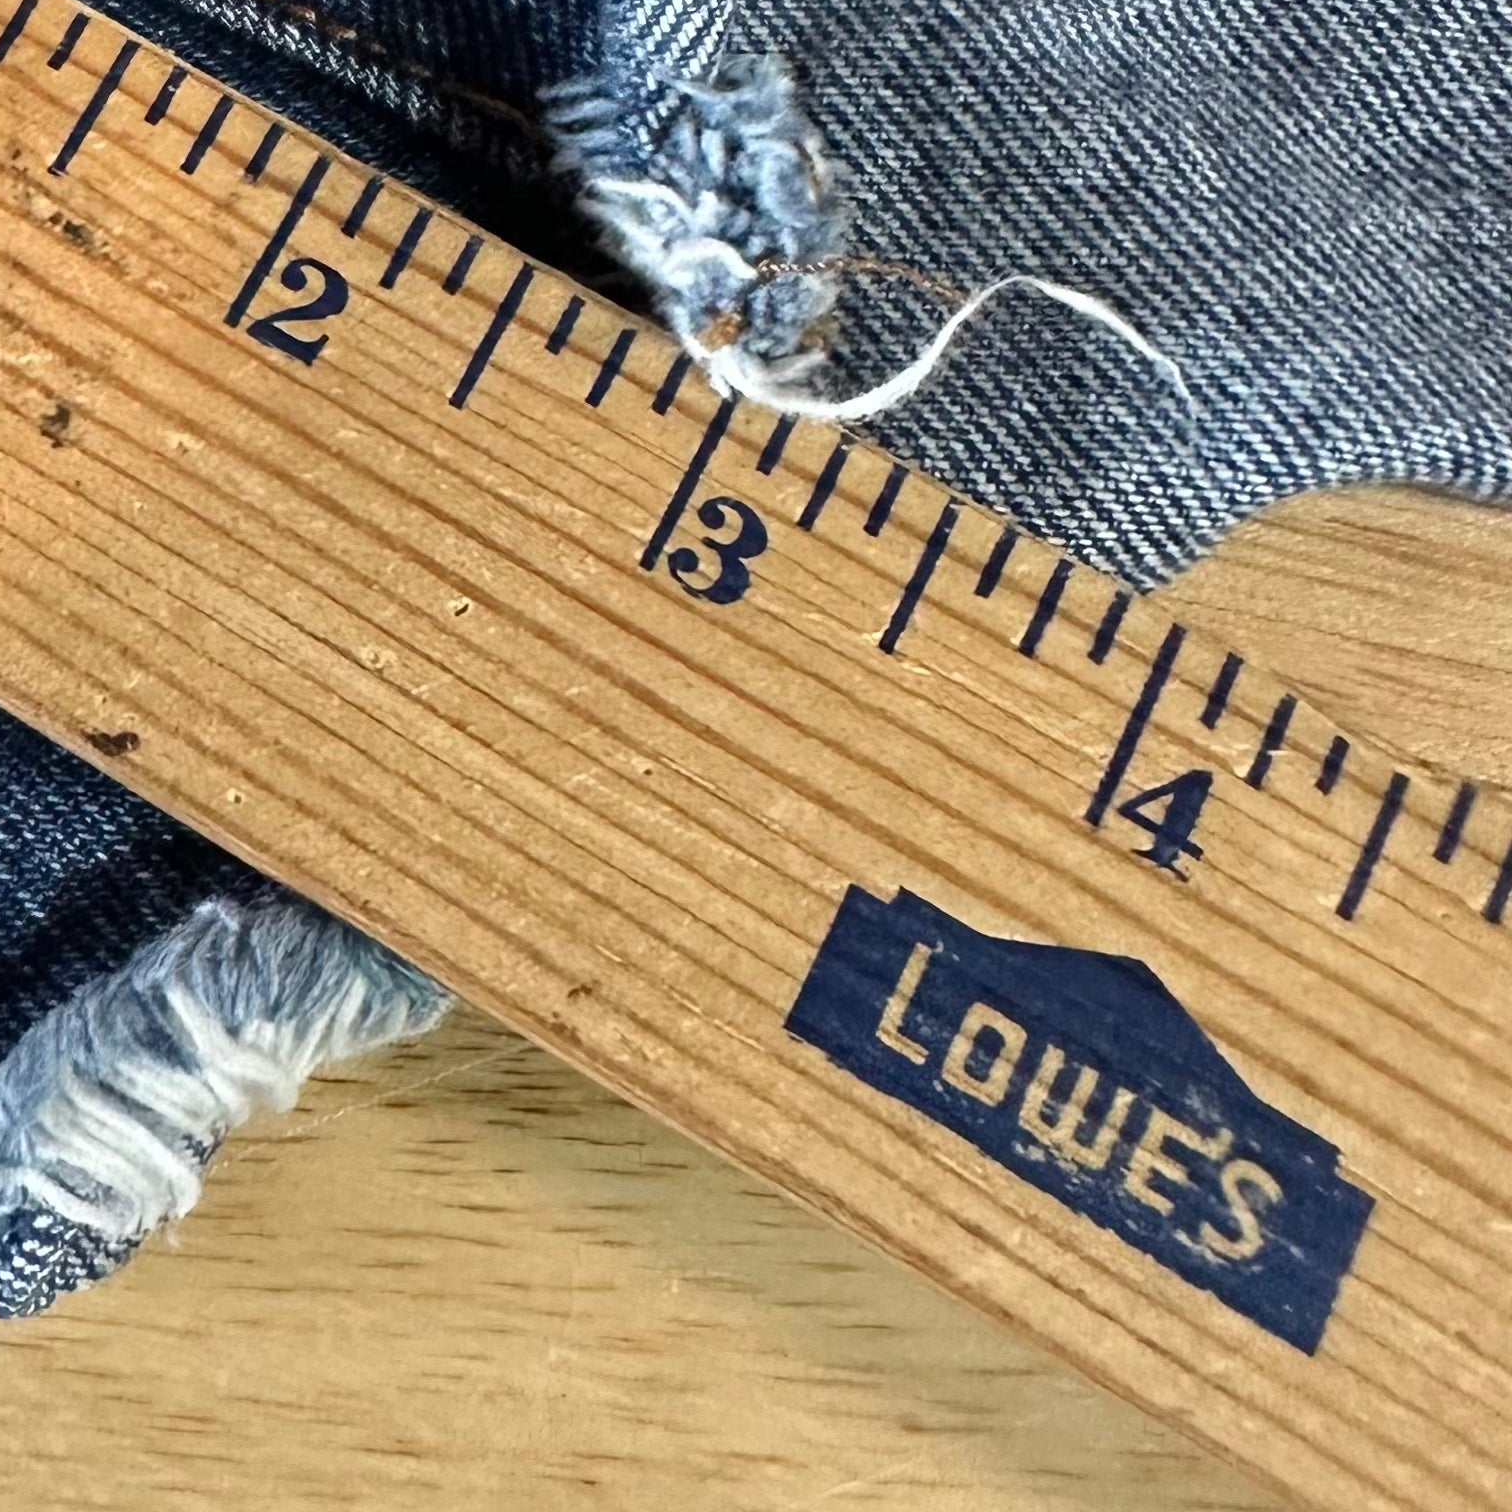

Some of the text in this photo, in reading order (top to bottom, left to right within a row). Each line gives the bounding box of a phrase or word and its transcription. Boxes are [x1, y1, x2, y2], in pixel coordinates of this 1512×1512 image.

[246, 257, 349, 367] 2
[668, 496, 768, 605] 3
[1117, 769, 1214, 882] 4
[875, 942, 1283, 1261] LOWE'S
